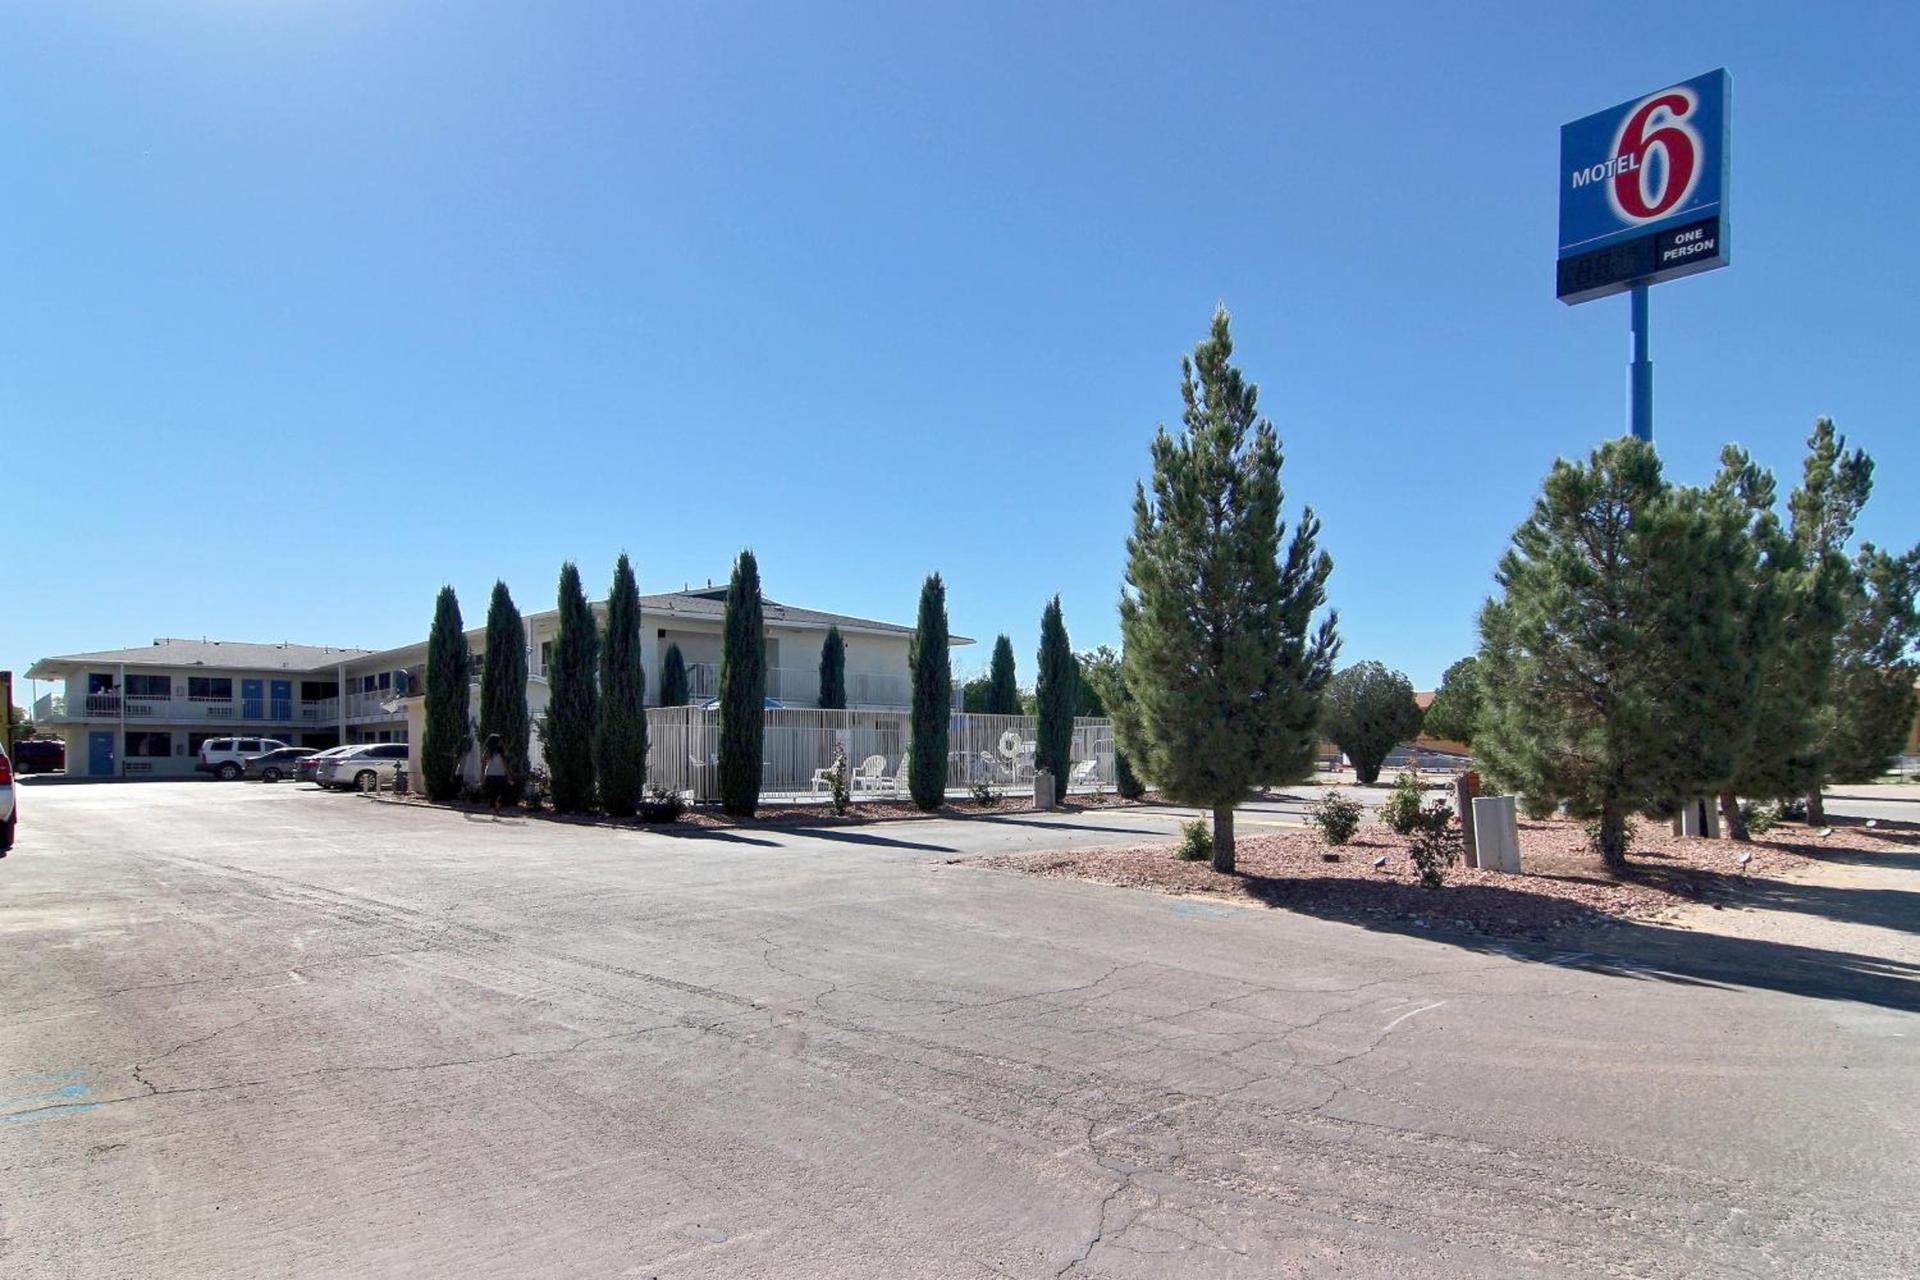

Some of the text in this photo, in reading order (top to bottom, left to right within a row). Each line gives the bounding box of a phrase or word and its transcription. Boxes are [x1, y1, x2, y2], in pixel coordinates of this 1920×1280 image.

[1572, 92, 1697, 220] MOTEL 6
[1675, 229, 1703, 245] ONE
[1663, 239, 1714, 261] PERSON
